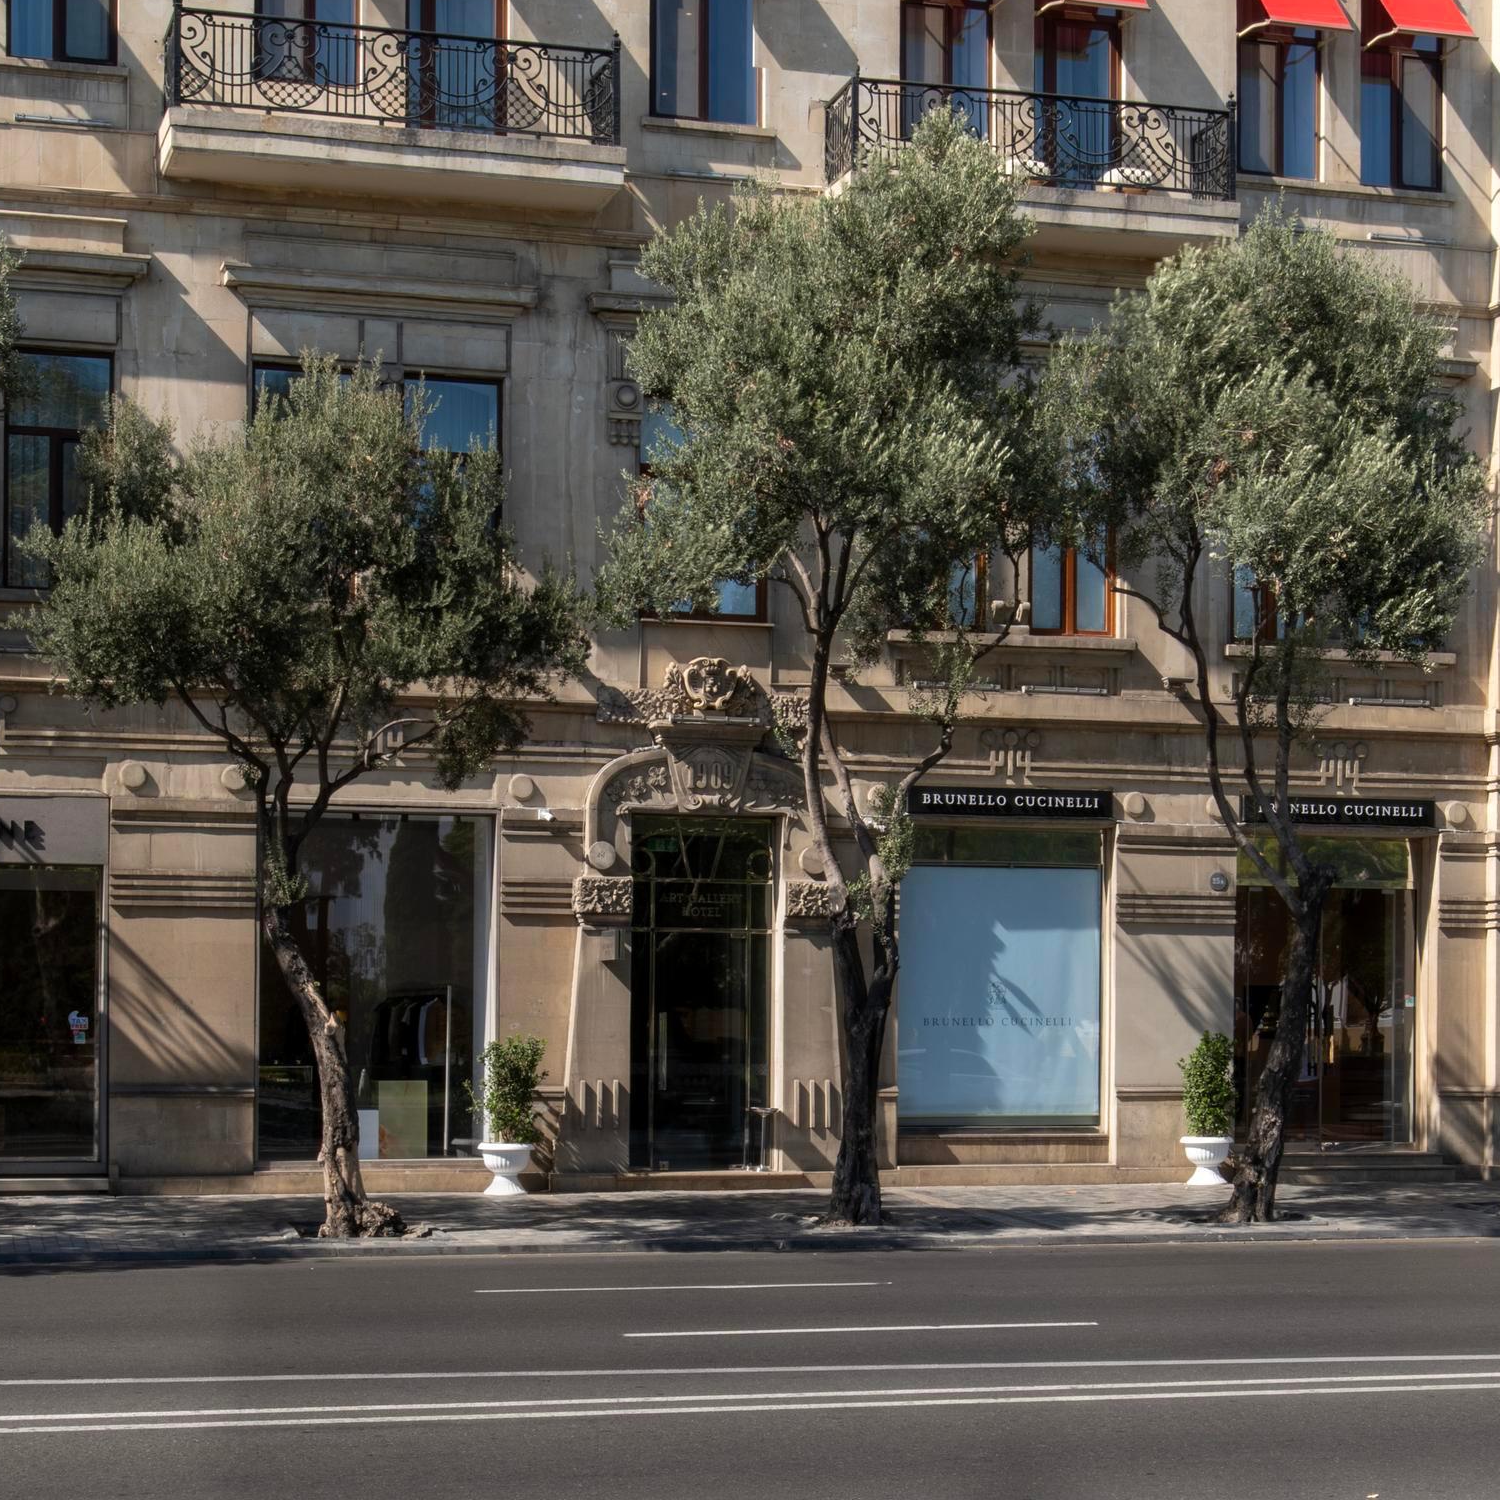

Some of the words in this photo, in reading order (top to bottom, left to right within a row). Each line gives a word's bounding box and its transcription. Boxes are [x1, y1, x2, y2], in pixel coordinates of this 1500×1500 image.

[686, 763, 734, 789] 1909
[922, 793, 1007, 806] BRUNELLO
[1014, 795, 1099, 808] CUCINELLI
[1258, 802, 1337, 815] RNELLO
[1344, 804, 1423, 817] CUCINELLI
[660, 892, 684, 903] ART
[682, 906, 723, 917] HOTEL
[923, 1017, 995, 1027] BRUNELLO
[1001, 1017, 1072, 1027] CUCINELLI
